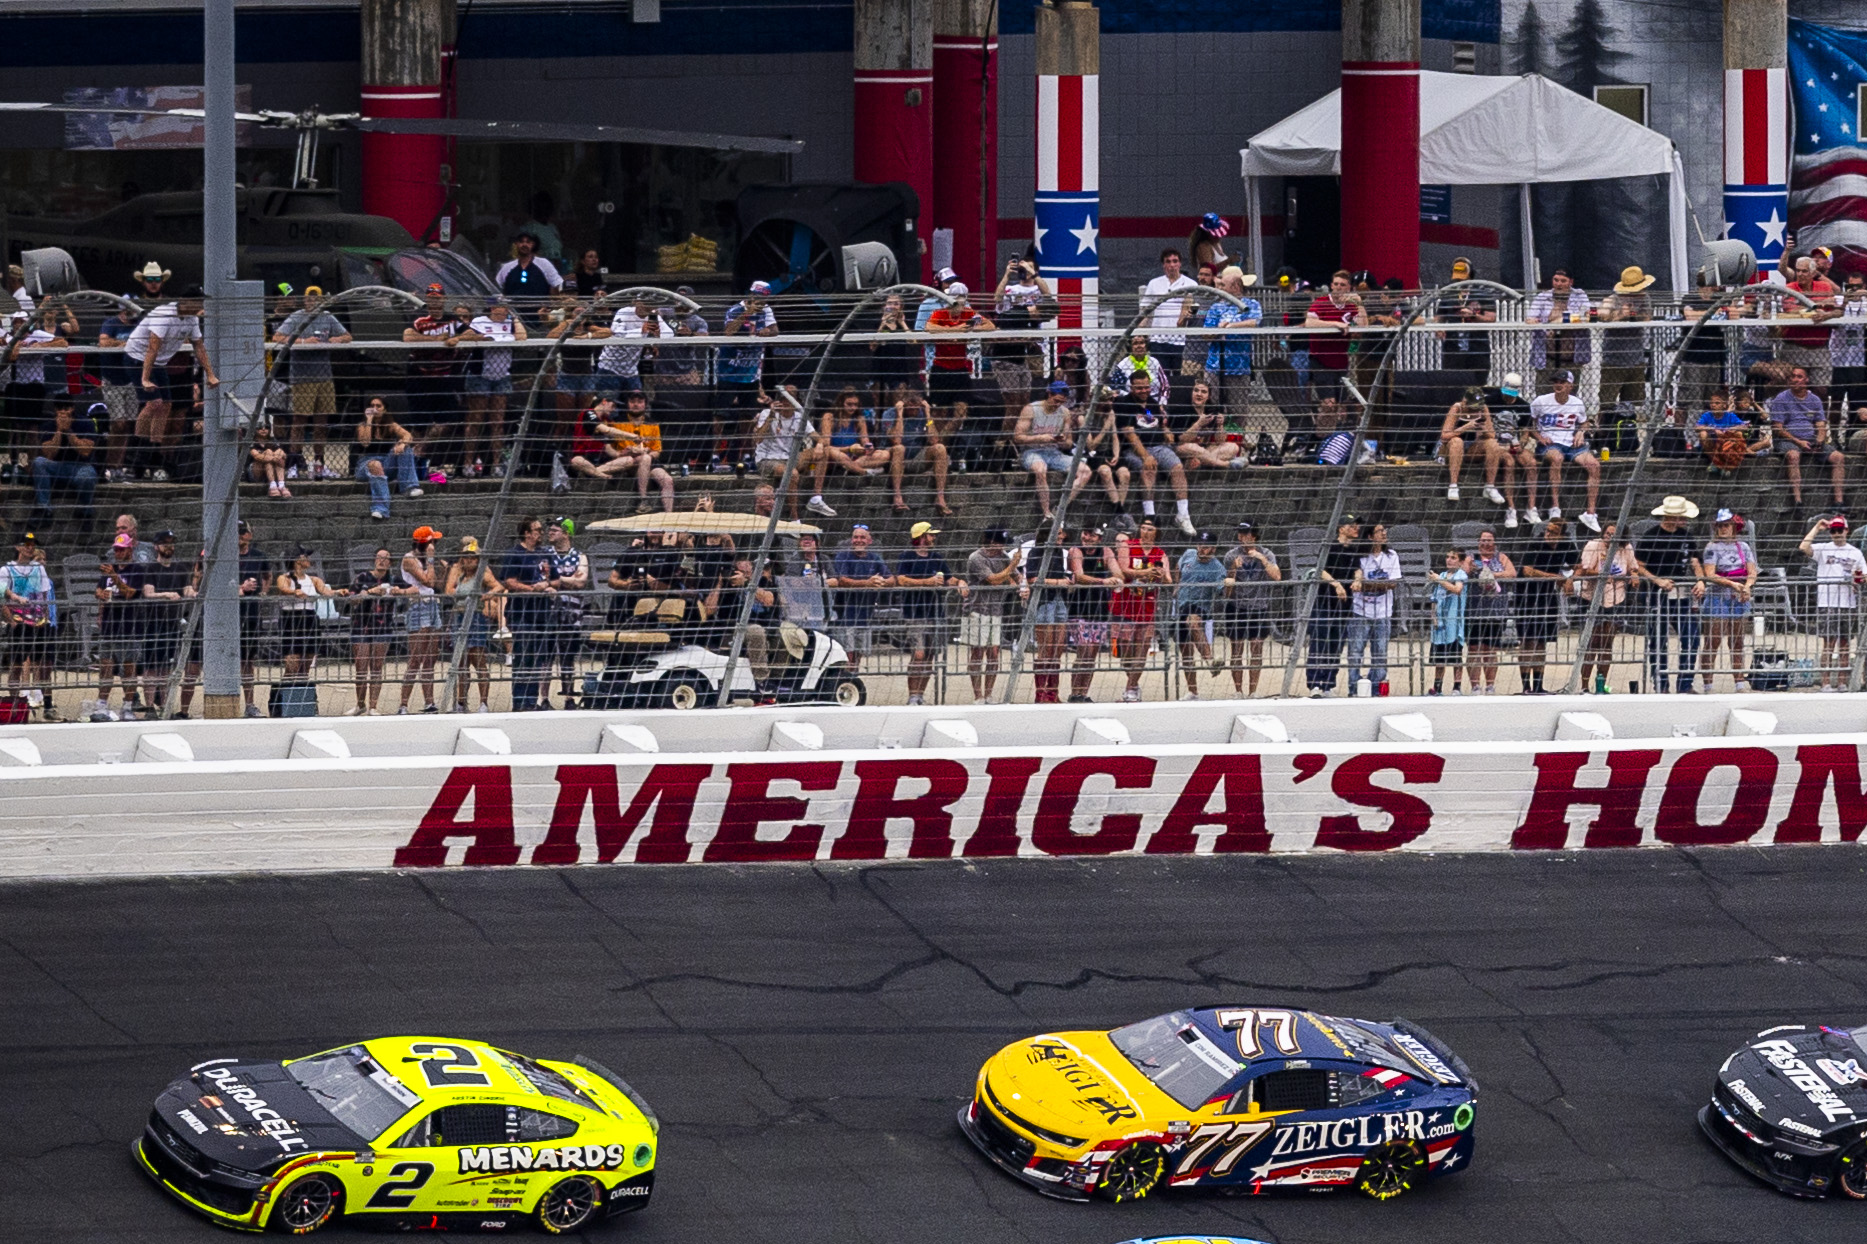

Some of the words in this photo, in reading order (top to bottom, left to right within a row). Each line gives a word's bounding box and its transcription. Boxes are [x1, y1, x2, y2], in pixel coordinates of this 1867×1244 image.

[393, 752, 1446, 867] AMERICA'S
[1216, 1009, 1302, 1060] 77
[409, 1042, 493, 1089] 2
[459, 1144, 625, 1174] MENARDS
[1171, 1118, 1276, 1178] 77
[365, 1160, 435, 1208] 2
